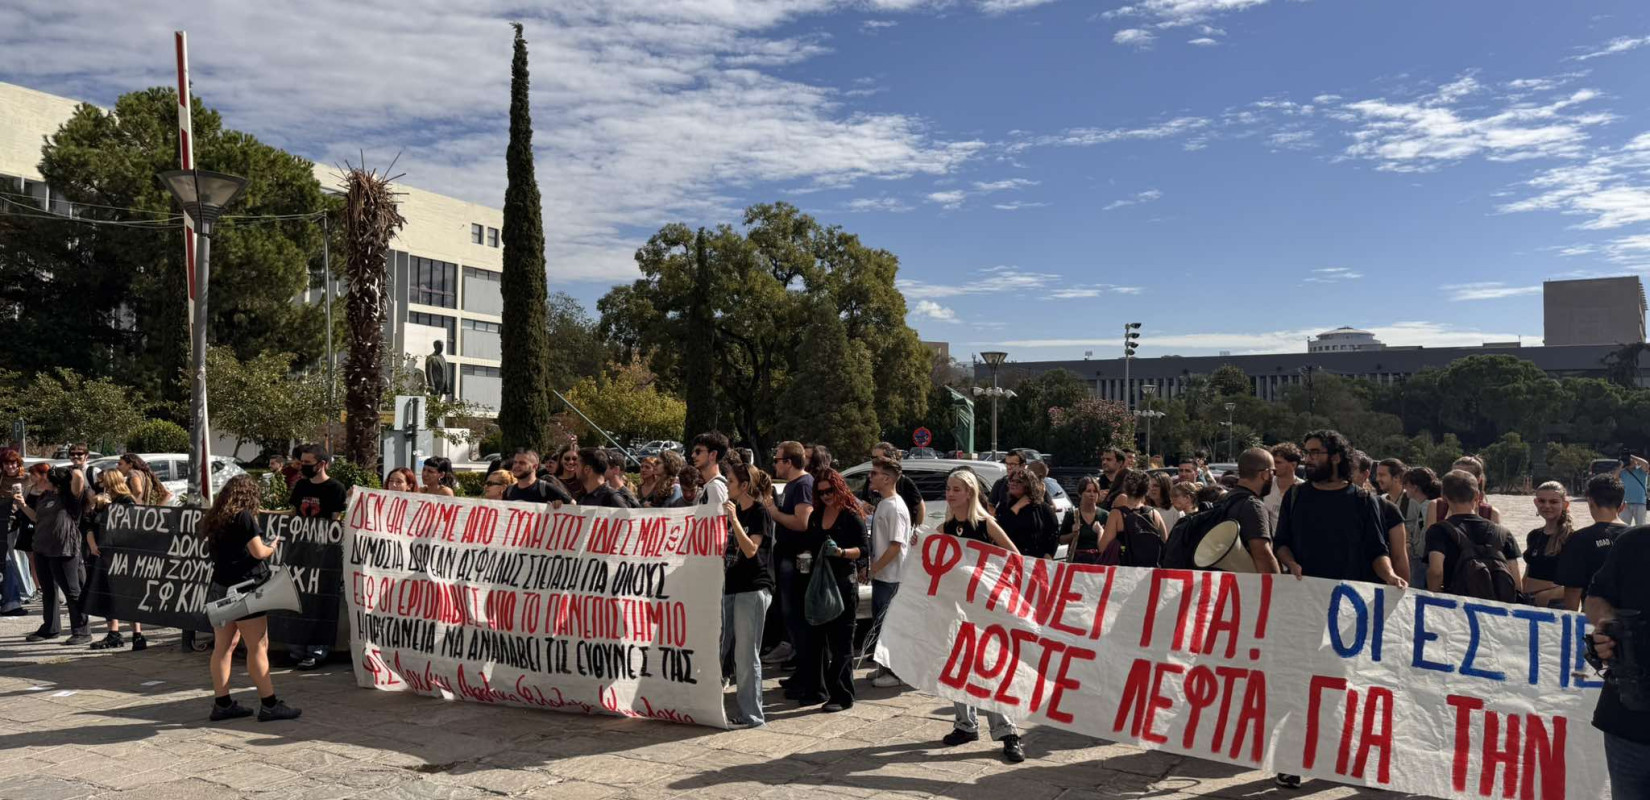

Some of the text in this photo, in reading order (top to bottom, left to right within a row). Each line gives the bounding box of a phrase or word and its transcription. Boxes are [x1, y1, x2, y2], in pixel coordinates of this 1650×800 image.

[106, 504, 172, 533] ΚΡΑΤΟΣ
[265, 514, 343, 545] ΚΕΦΑΛΑΙΟ
[350, 491, 387, 532] ΔΕΝ
[386, 496, 409, 535] ΘΑ
[407, 499, 463, 542] ΖΟΥΜΕ
[460, 505, 499, 545] ΑΠΟ
[502, 507, 549, 549] ΤΥΧΗ
[545, 512, 587, 552] ΣΤΙΣ
[632, 516, 671, 557] ΜΑΣ
[108, 553, 129, 575] ΝΑ
[132, 555, 165, 579] ΜΗΝ
[165, 559, 215, 584] ΖΟΥΜ
[408, 542, 458, 580] ΔΩΡΕΑΝ
[456, 547, 528, 588] ΑΣΦΑΛΗΣ
[522, 554, 583, 591] ΣΤΕΓΑΣΗ
[580, 558, 609, 593] ΓΙΑ
[611, 560, 670, 600] ΟΛΟΥΣ
[921, 533, 1116, 640] ΦΤΑΝΕΙ
[1139, 568, 1273, 660] ΠΙΑ!
[1327, 582, 1384, 662] ΟΙ
[353, 571, 687, 648] ΕΞΩ ΟΙ ΕΡΓΟΛΑΒΙΕΣ ΑΠΟ ΤΟ ΠΑΝΕΠΙΣΤΗΜΙΟ
[364, 613, 436, 654] ΠΡΥΤΑΝΕΙΑ
[441, 625, 464, 659] ΝΑ
[467, 628, 541, 673] ΑΝΑΛΑΒΕΙ
[545, 636, 572, 674] ΤΙΣ
[576, 638, 652, 680] ΕΥΘΥΝΕΣ
[658, 646, 697, 685] ΤΗΣ
[1112, 658, 1267, 763] ΛΕΦΤΑ
[1302, 675, 1394, 784] ΓΙΑ
[1446, 694, 1567, 800] ΤΗΝ
